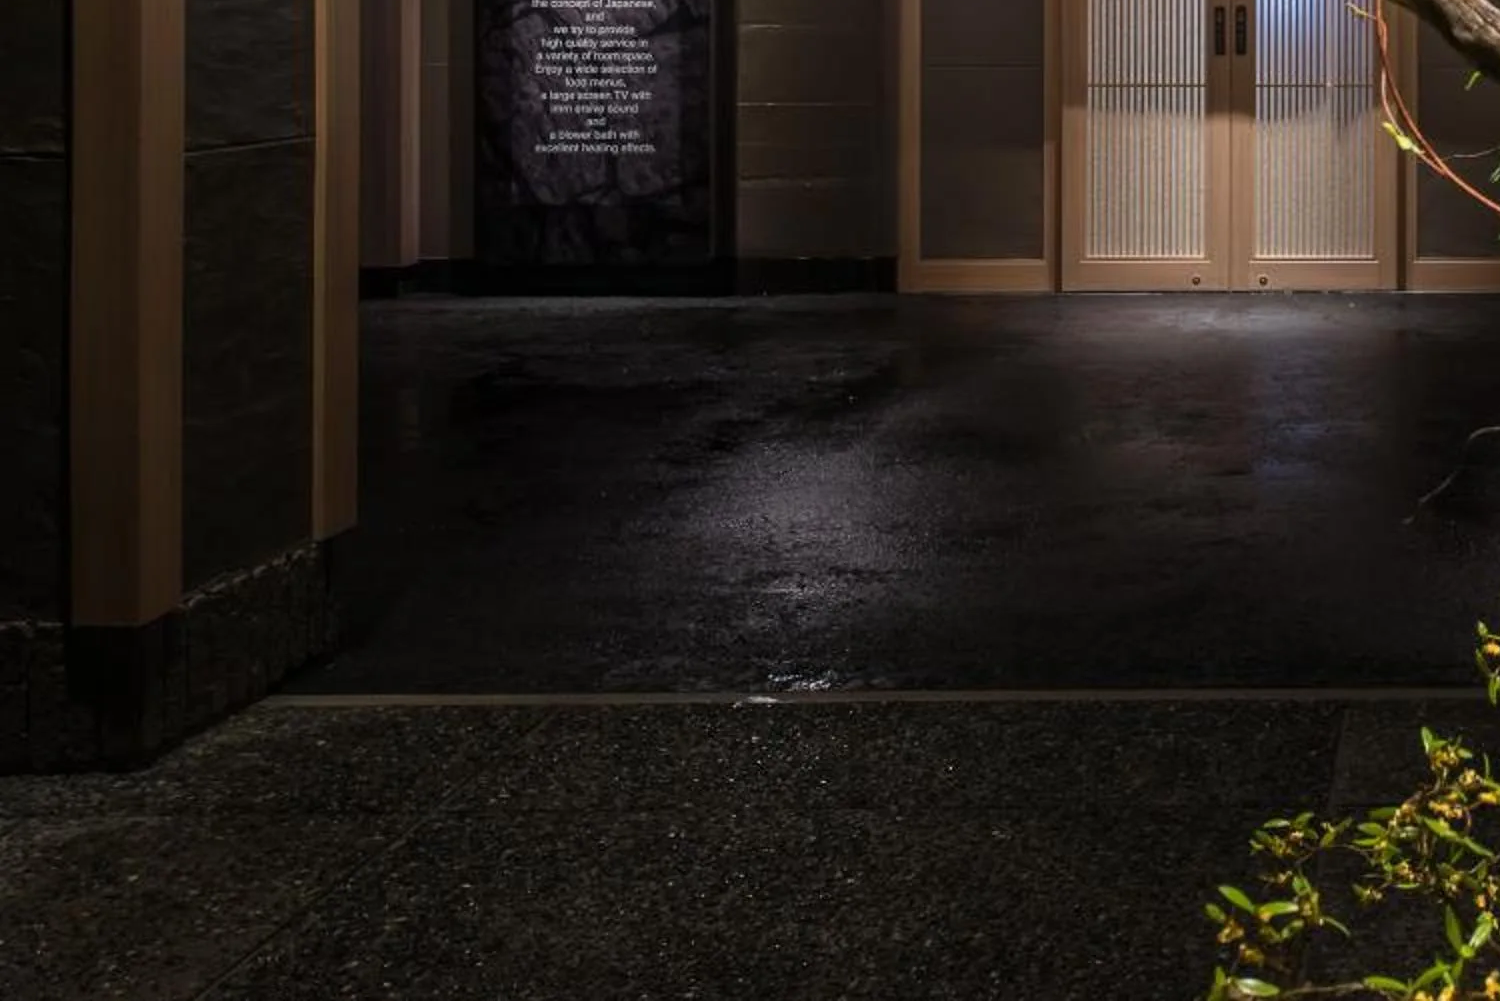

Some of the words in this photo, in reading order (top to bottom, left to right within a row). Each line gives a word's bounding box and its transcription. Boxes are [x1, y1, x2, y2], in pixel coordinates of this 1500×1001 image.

[531, 0, 549, 10] the
[550, 0, 591, 10] concept
[591, 0, 603, 10] of
[585, 12, 605, 22] and
[553, 26, 569, 36] we
[570, 26, 584, 36] try
[585, 26, 596, 36] to
[598, 26, 636, 36] provide
[541, 39, 563, 50] high
[565, 39, 599, 50] quality
[600, 39, 637, 50] service
[639, 39, 649, 50] in
[536, 52, 543, 63] a
[545, 52, 579, 63] variety
[581, 52, 592, 63] of
[535, 65, 563, 76] Enjoy
[565, 65, 573, 76] a
[575, 65, 599, 76] wide
[600, 65, 645, 76] selection
[647, 65, 657, 76] of
[565, 78, 587, 88] food
[549, 90, 575, 101] large
[577, 90, 612, 101] screen
[613, 90, 629, 101] TV
[630, 90, 653, 101] with
[607, 104, 639, 114] sound
[586, 117, 607, 126] and
[559, 130, 592, 140] blower
[594, 130, 617, 140] bath
[619, 130, 641, 140] with
[536, 143, 579, 154] excellent
[581, 143, 619, 154] healing
